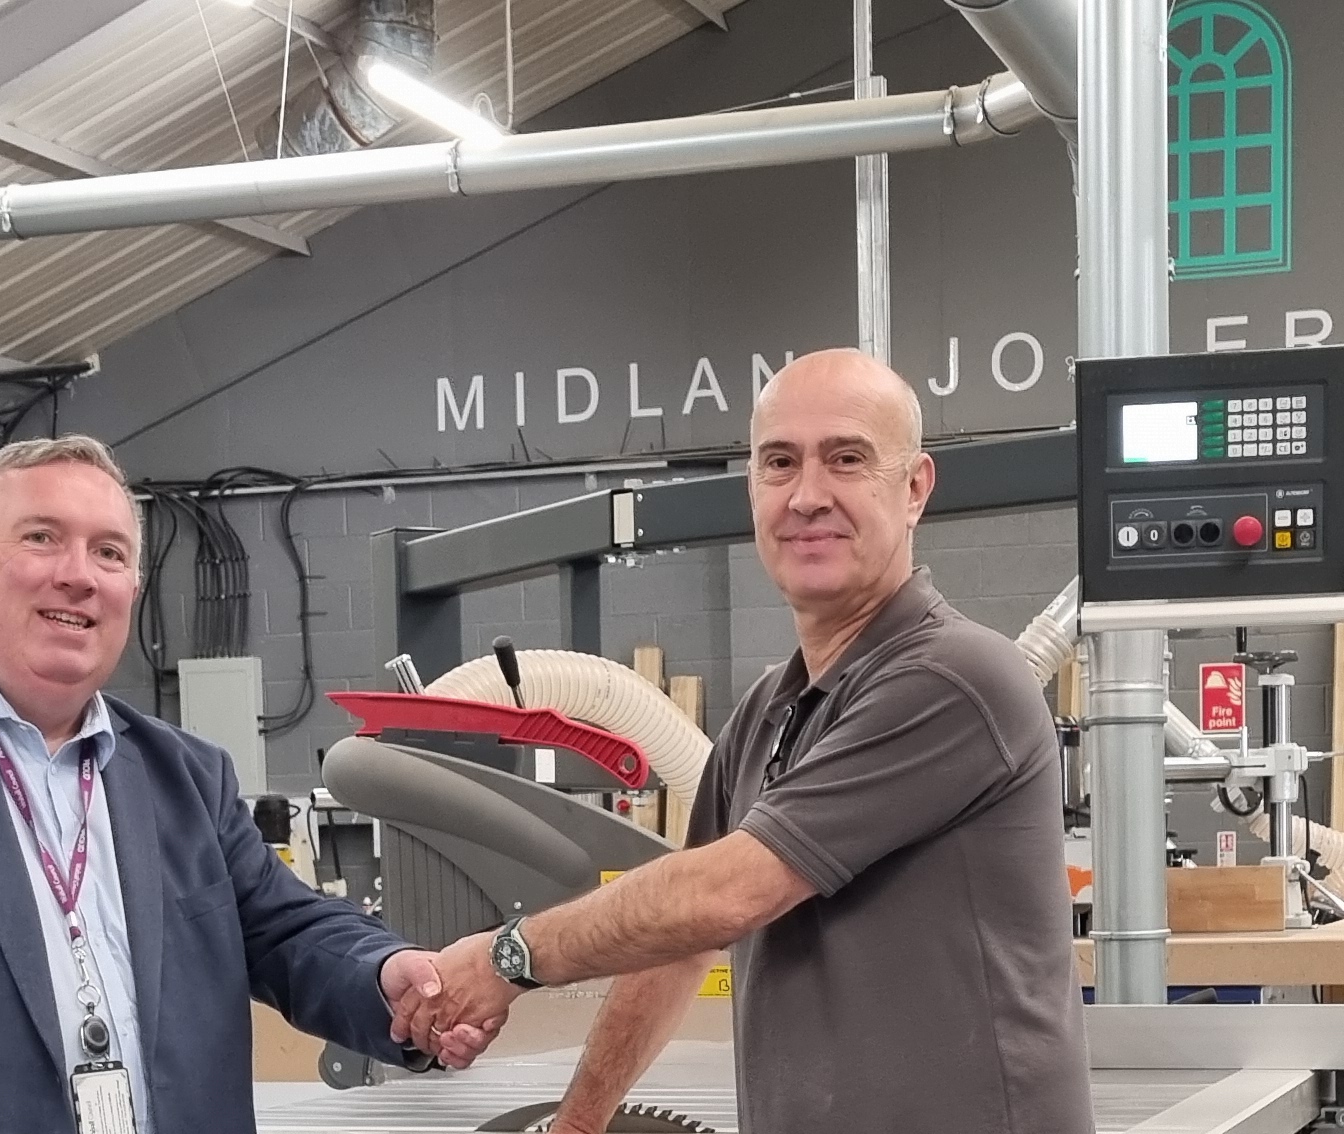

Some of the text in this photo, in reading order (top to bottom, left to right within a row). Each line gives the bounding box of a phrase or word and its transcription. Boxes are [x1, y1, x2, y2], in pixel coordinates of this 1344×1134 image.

[436, 350, 794, 432] MIDLAN
[1212, 706, 1233, 717] Fire
[1209, 717, 1236, 730] point
